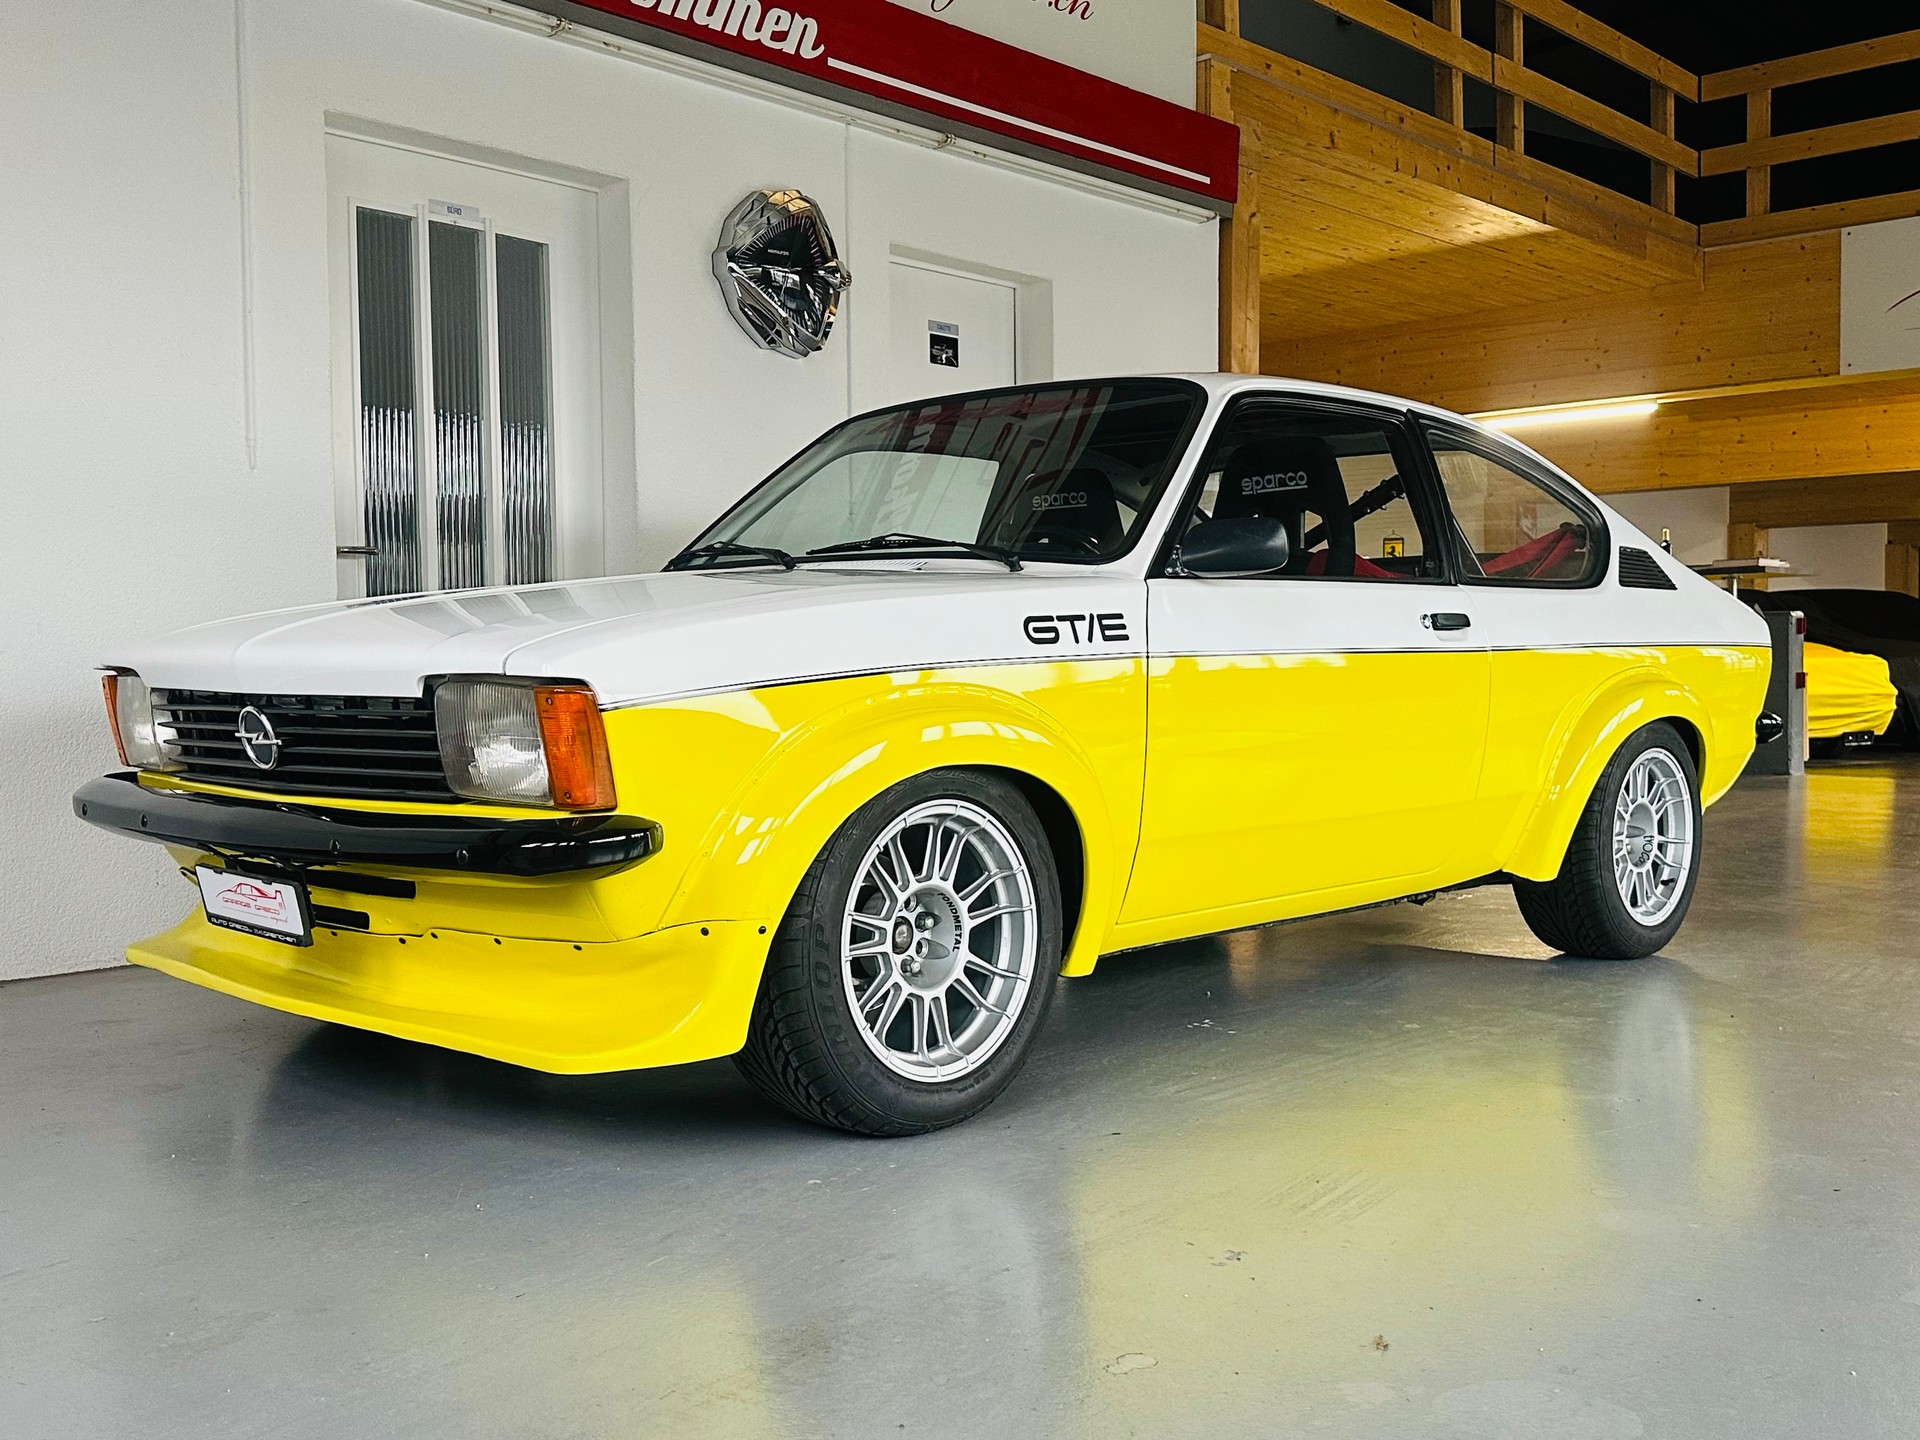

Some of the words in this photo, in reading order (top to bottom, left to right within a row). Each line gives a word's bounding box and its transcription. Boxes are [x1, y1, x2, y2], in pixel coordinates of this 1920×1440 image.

[1240, 471, 1309, 495] sparco
[1032, 490, 1088, 511] sparco
[1023, 613, 1130, 645] GT/E
[936, 892, 963, 953] FONDMETAL
